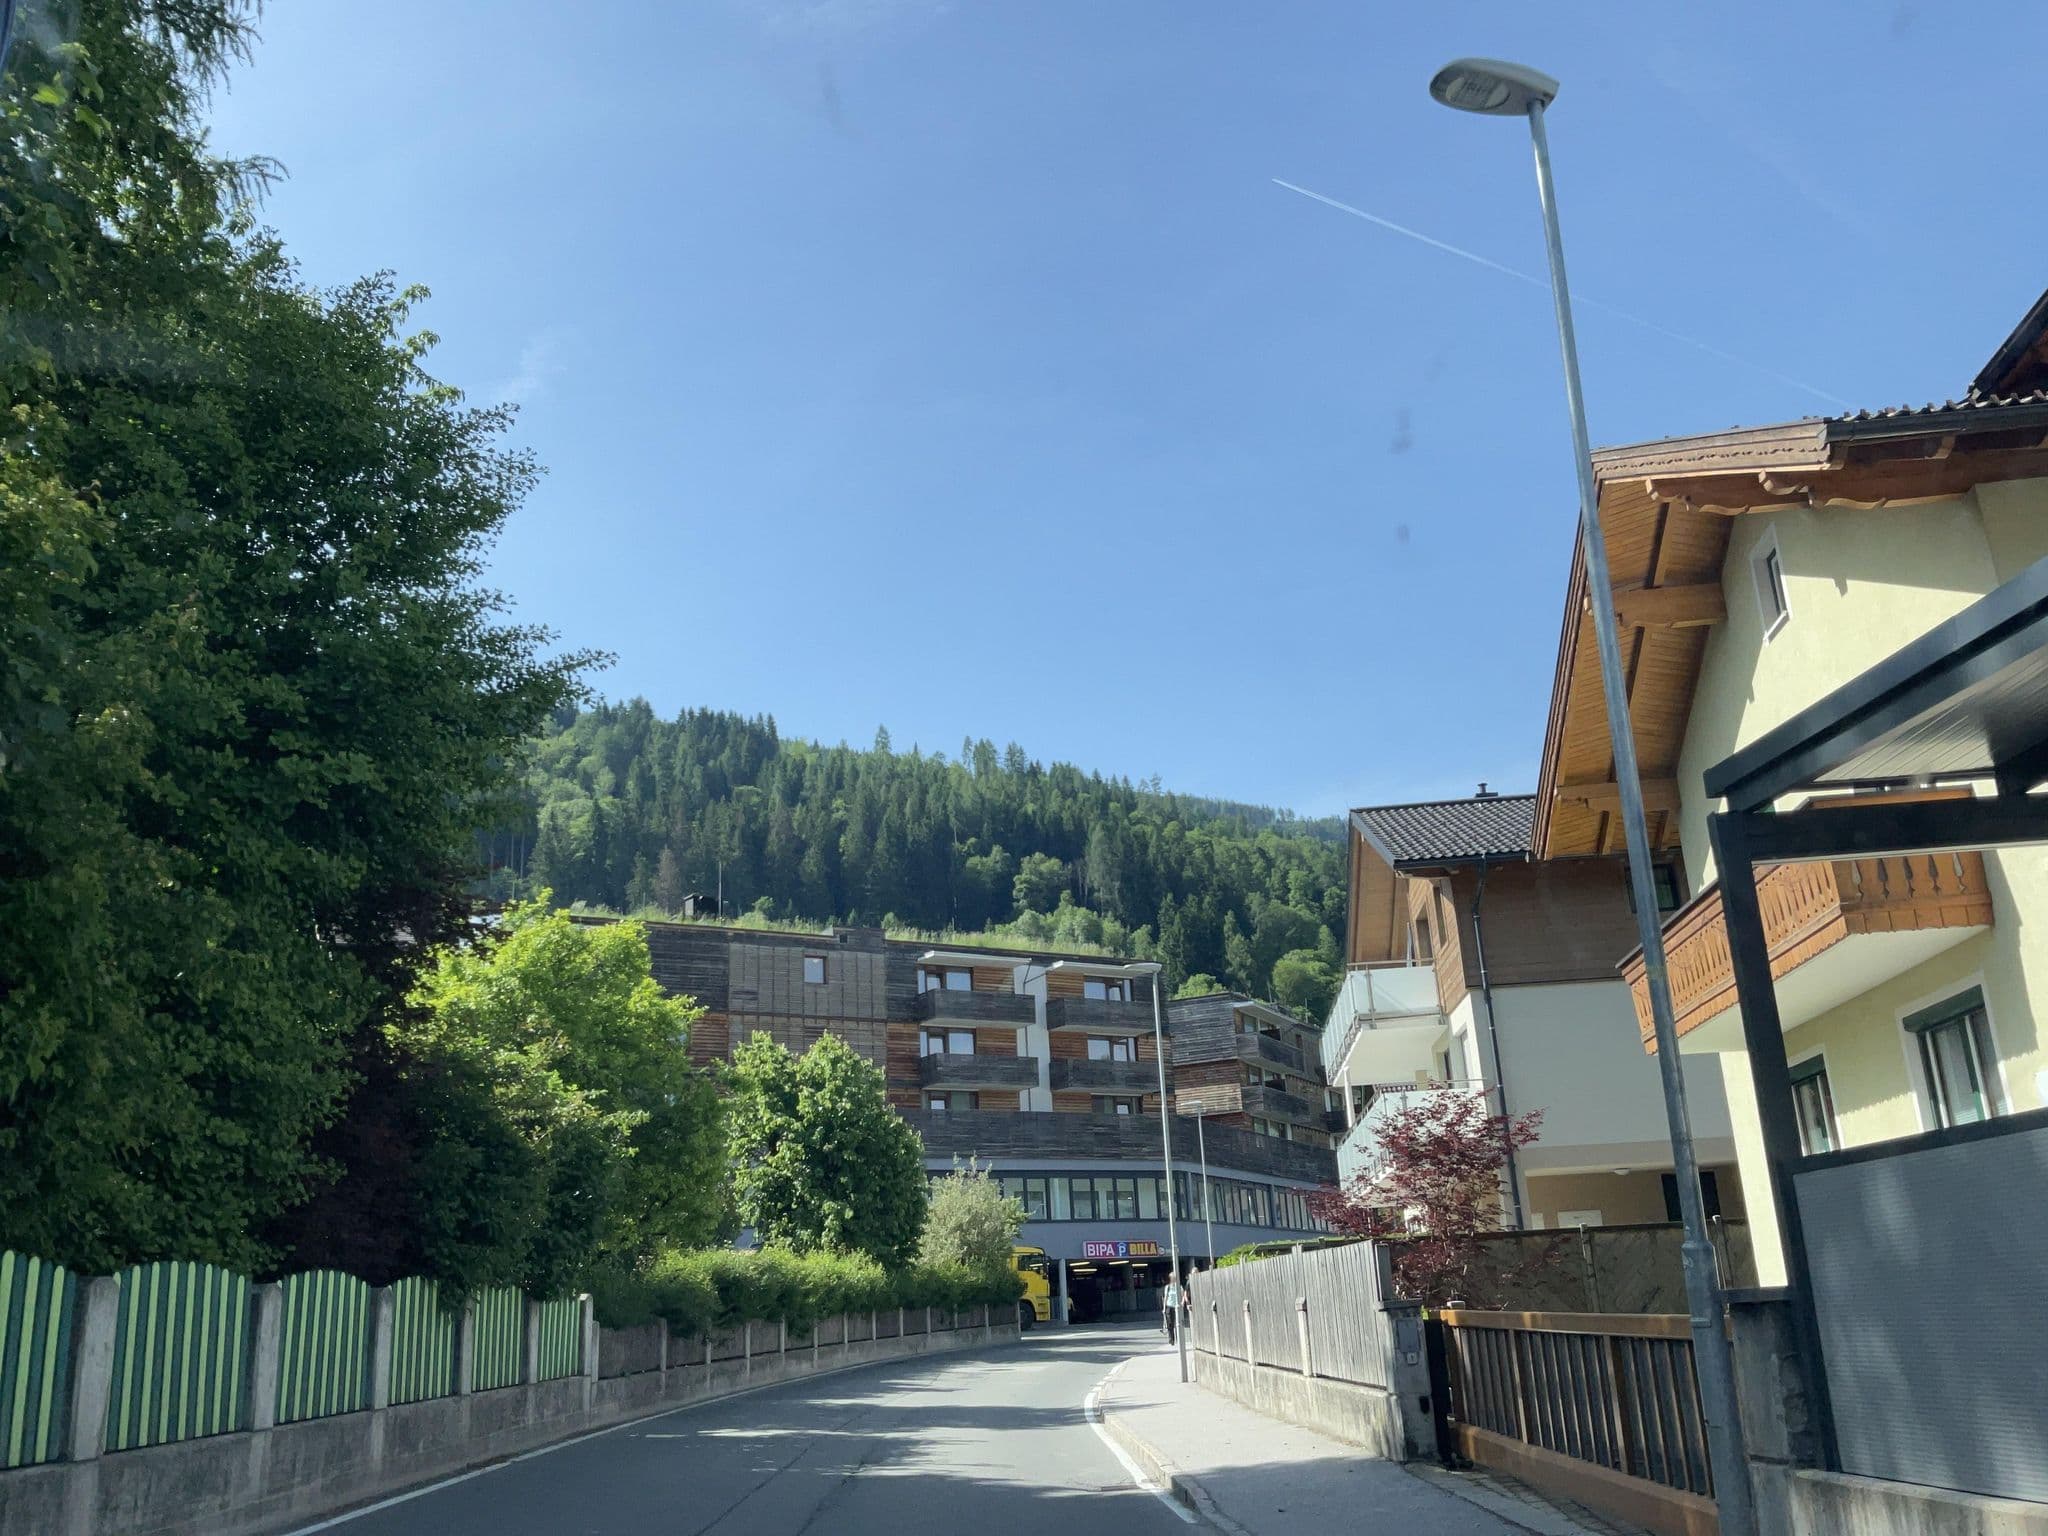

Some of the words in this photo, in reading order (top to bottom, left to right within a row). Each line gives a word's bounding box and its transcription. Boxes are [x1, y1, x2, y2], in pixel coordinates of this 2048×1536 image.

[1087, 1244, 1115, 1256] BIPA
[1118, 1245, 1126, 1256] P
[1129, 1243, 1157, 1255] BILLA
